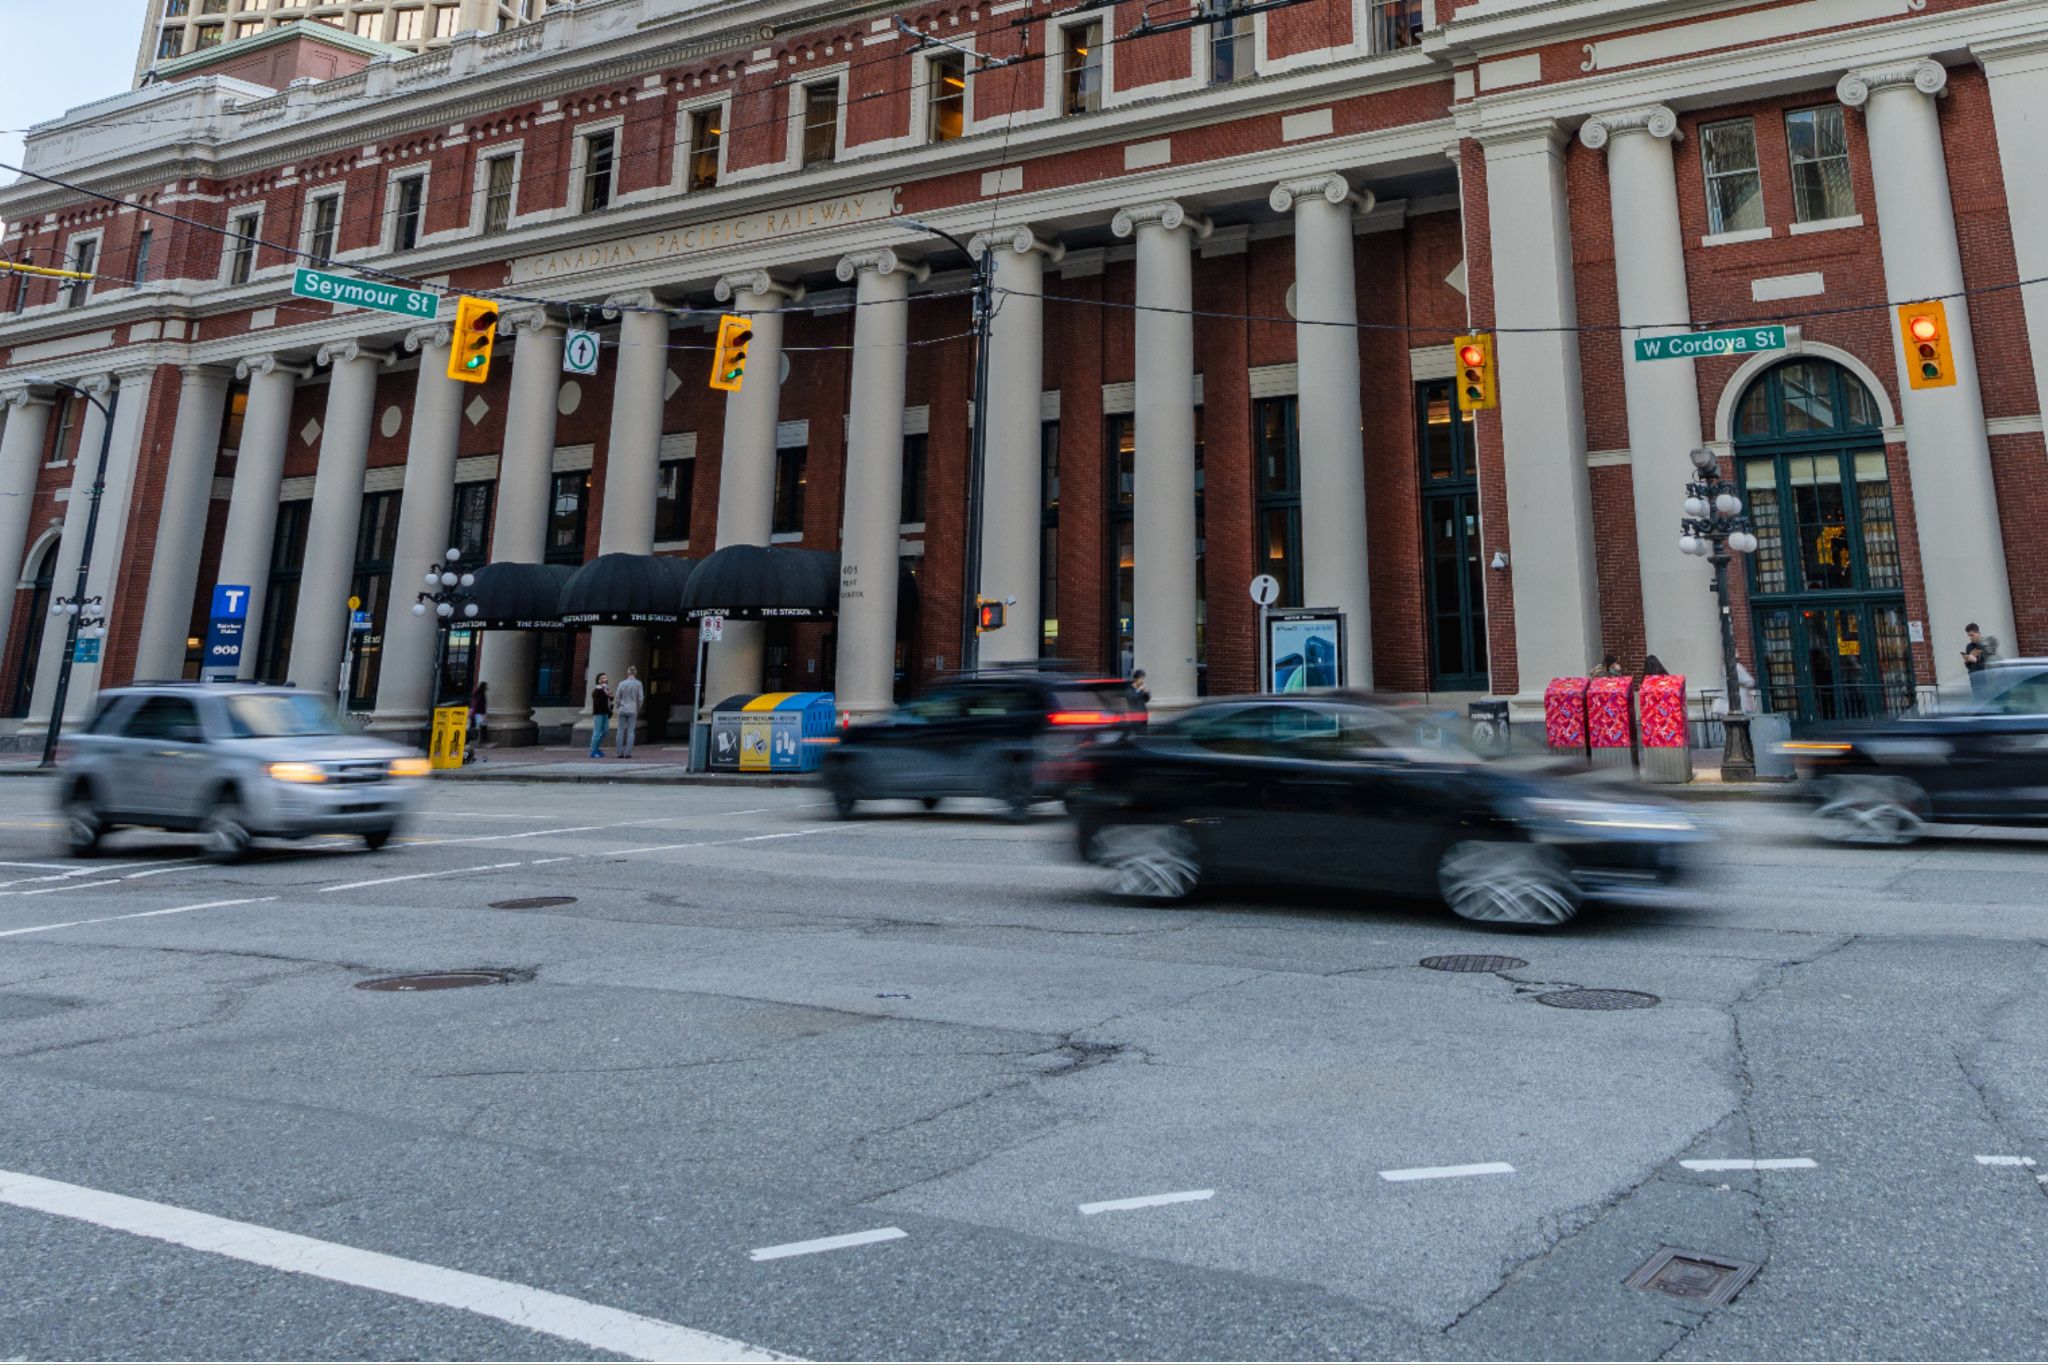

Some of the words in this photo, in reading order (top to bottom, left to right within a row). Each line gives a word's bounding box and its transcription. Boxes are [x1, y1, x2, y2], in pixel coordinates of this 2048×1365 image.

[532, 244, 636, 276] CANADIAN
[655, 220, 746, 254] PACIFIC
[767, 198, 866, 233] RAILWAY
[304, 273, 398, 306] Seymour
[406, 292, 429, 312] St
[1643, 340, 1661, 357] W
[1668, 335, 1747, 354] Cordova
[1755, 330, 1777, 348] St
[225, 590, 244, 613] T
[761, 608, 778, 616] THE
[779, 608, 812, 616] STATION
